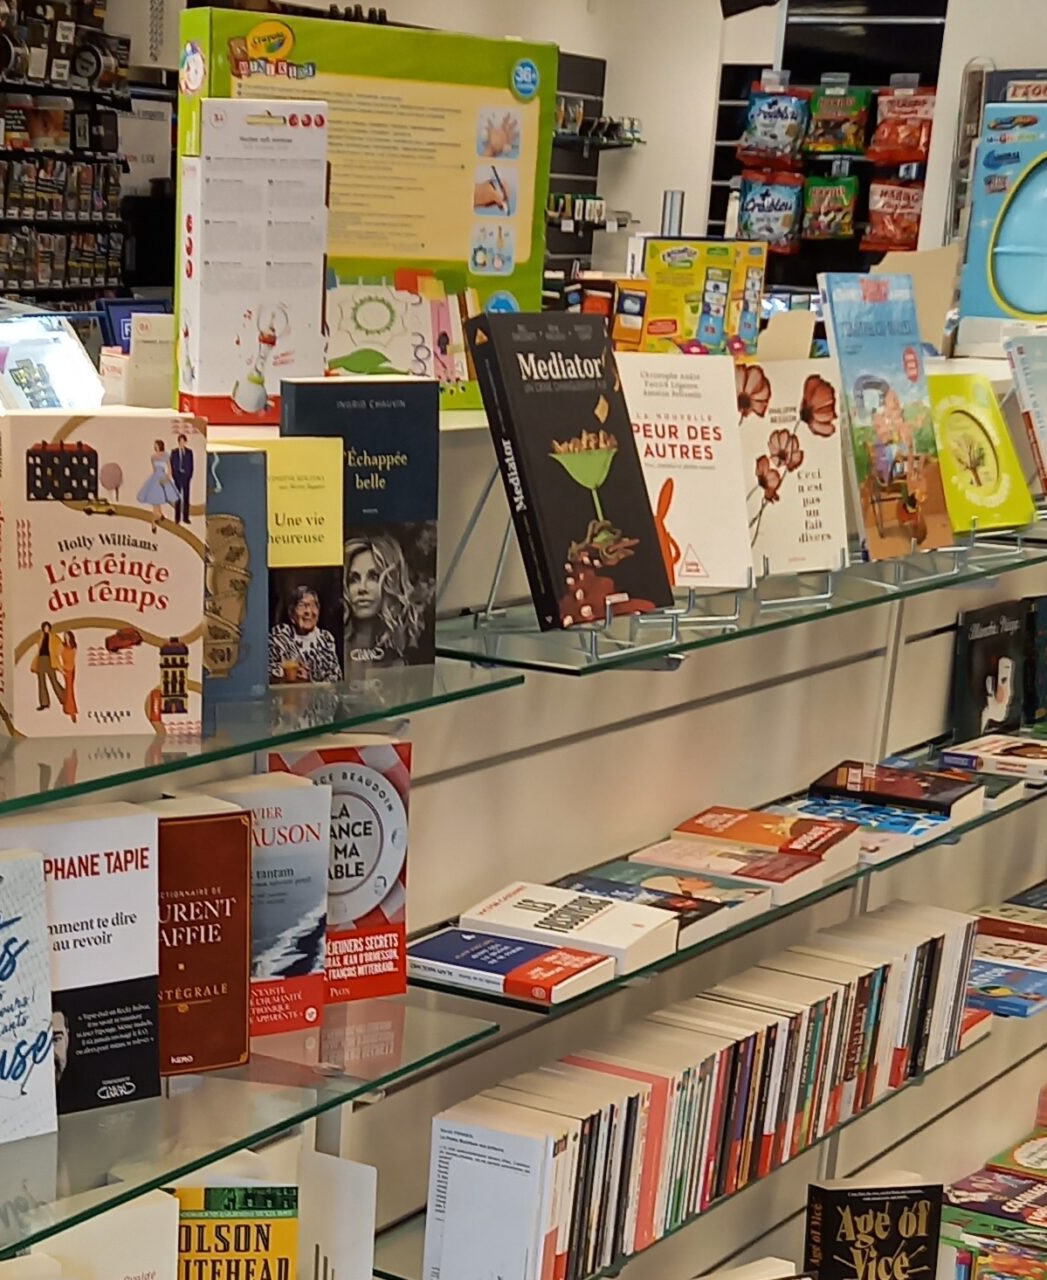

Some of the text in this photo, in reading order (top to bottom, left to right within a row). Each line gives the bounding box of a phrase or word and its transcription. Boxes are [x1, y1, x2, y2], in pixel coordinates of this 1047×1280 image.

[516, 351, 602, 380] Mediator
[632, 423, 722, 441] PEUR DES
[644, 443, 713, 460] AUTRES
[355, 472, 386, 490] belle
[797, 468, 822, 479] Ceci
[274, 511, 325, 527] Une vie
[57, 532, 159, 554] Holly Williams
[799, 532, 832, 543] divers
[44, 553, 169, 585] L'étreinte
[47, 581, 169, 614] du temps
[257, 867, 294, 880] tantam
[364, 933, 399, 951] SECRETS
